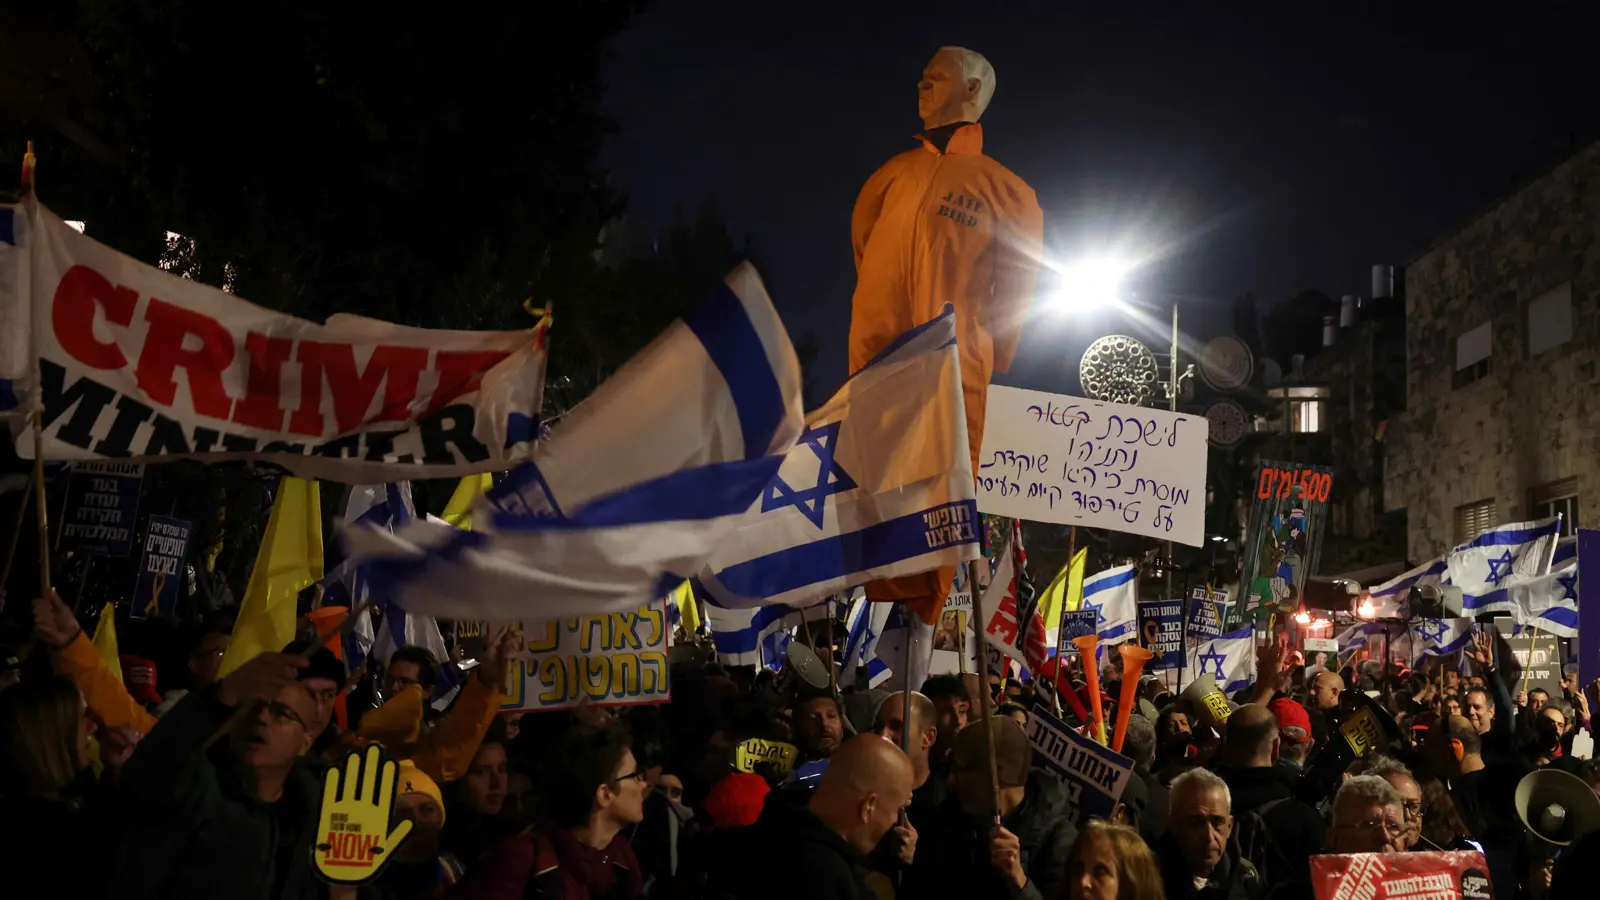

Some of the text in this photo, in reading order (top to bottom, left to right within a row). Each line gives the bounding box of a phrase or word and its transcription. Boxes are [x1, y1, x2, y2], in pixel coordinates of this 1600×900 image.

[1027, 402, 1187, 447] לישכת קטאר
[1069, 438, 1138, 471] נתניהו
[981, 450, 1189, 505] מוסרת כי היא שוקדת
[1258, 466, 1332, 503] 500 ימים
[1027, 482, 1062, 509] קיום
[923, 504, 972, 530] חופשי
[1153, 505, 1173, 532] על
[146, 534, 186, 557] חופשיים
[924, 521, 975, 548] בארצנו
[147, 553, 178, 576] בארצנו
[1162, 621, 1181, 632] בעד
[1029, 721, 1120, 792] אנחנו הרוב
[324, 832, 380, 861] NOW
